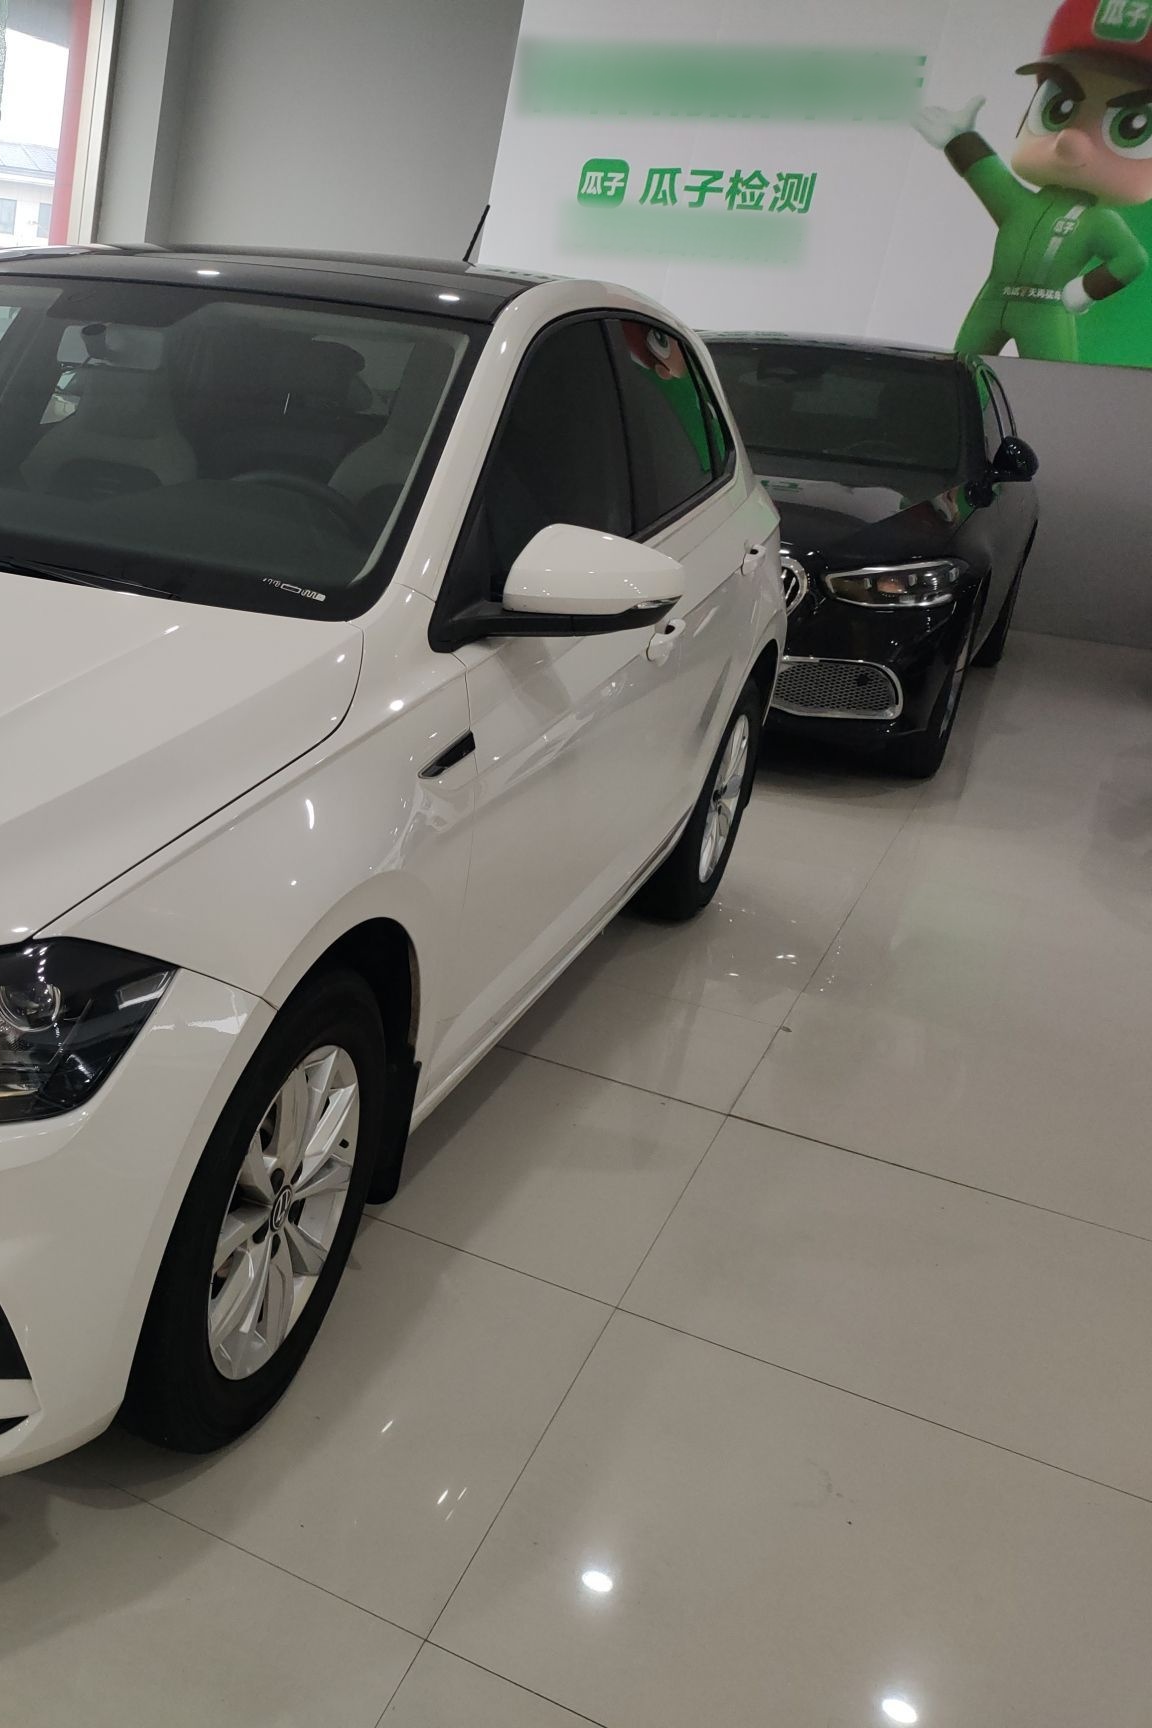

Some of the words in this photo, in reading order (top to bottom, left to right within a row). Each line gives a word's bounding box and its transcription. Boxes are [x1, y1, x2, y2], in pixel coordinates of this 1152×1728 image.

[1100, 0, 1149, 28] 瓜子
[580, 171, 625, 197] 瓜子
[638, 167, 818, 214] 瓜子检测
